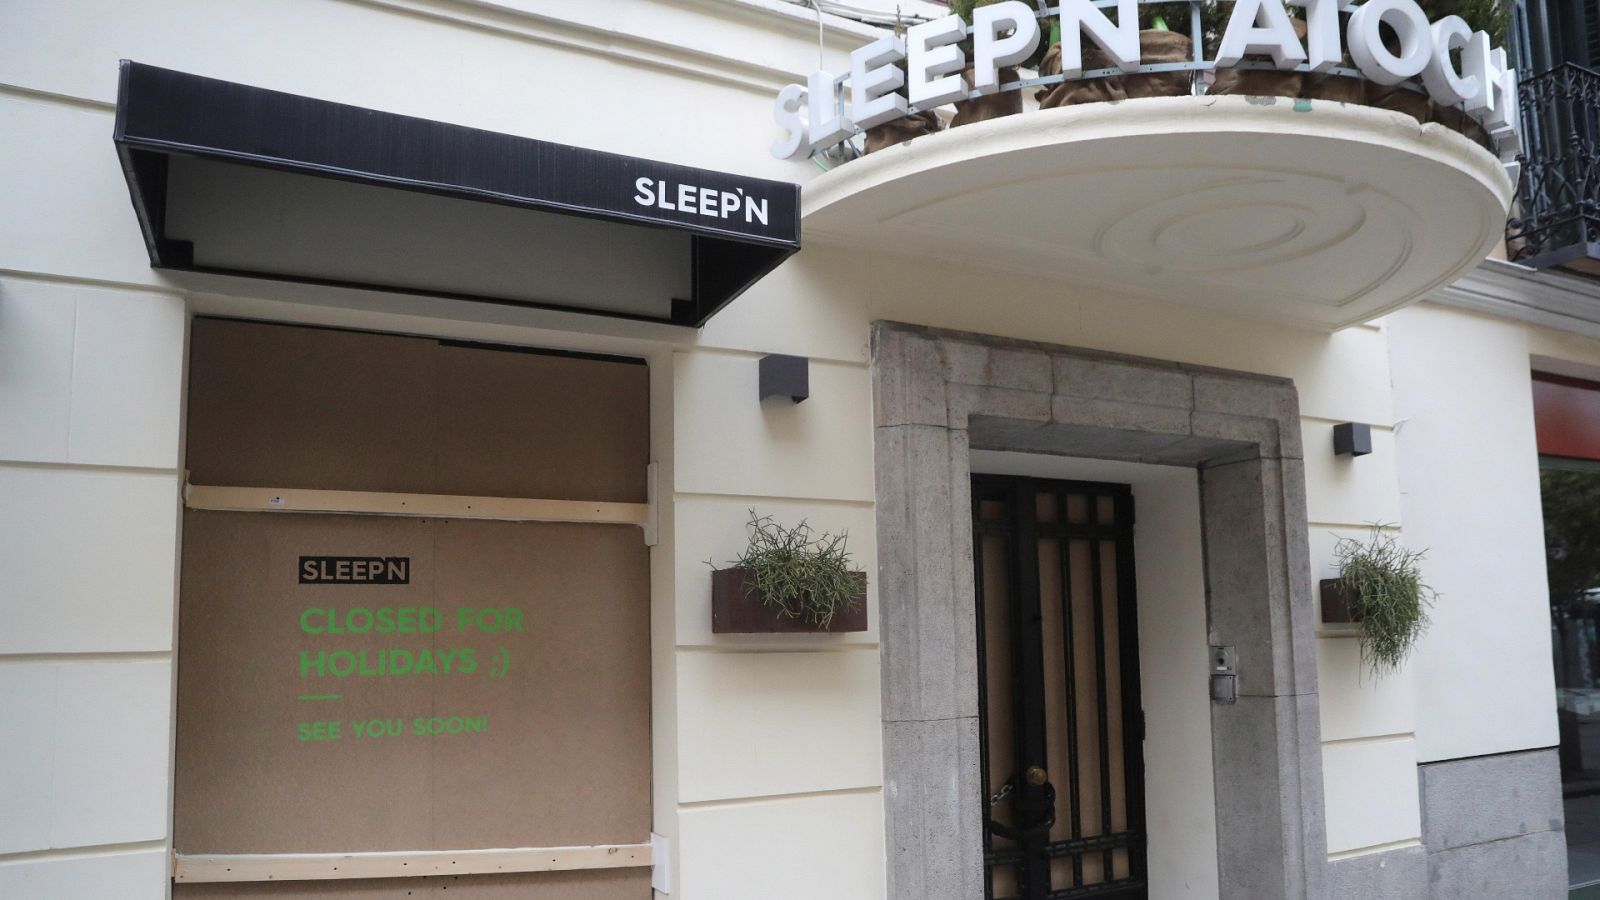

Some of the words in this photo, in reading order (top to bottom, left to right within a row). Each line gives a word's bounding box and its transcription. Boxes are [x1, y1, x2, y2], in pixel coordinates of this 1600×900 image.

[634, 176, 768, 226] SLEEP'N
[299, 607, 444, 635] CLOSED
[457, 607, 525, 633] FOR
[299, 647, 479, 678] HOLIDAYS
[297, 720, 341, 742] SEE
[352, 719, 403, 739] YOU
[412, 714, 489, 736] SOON!
